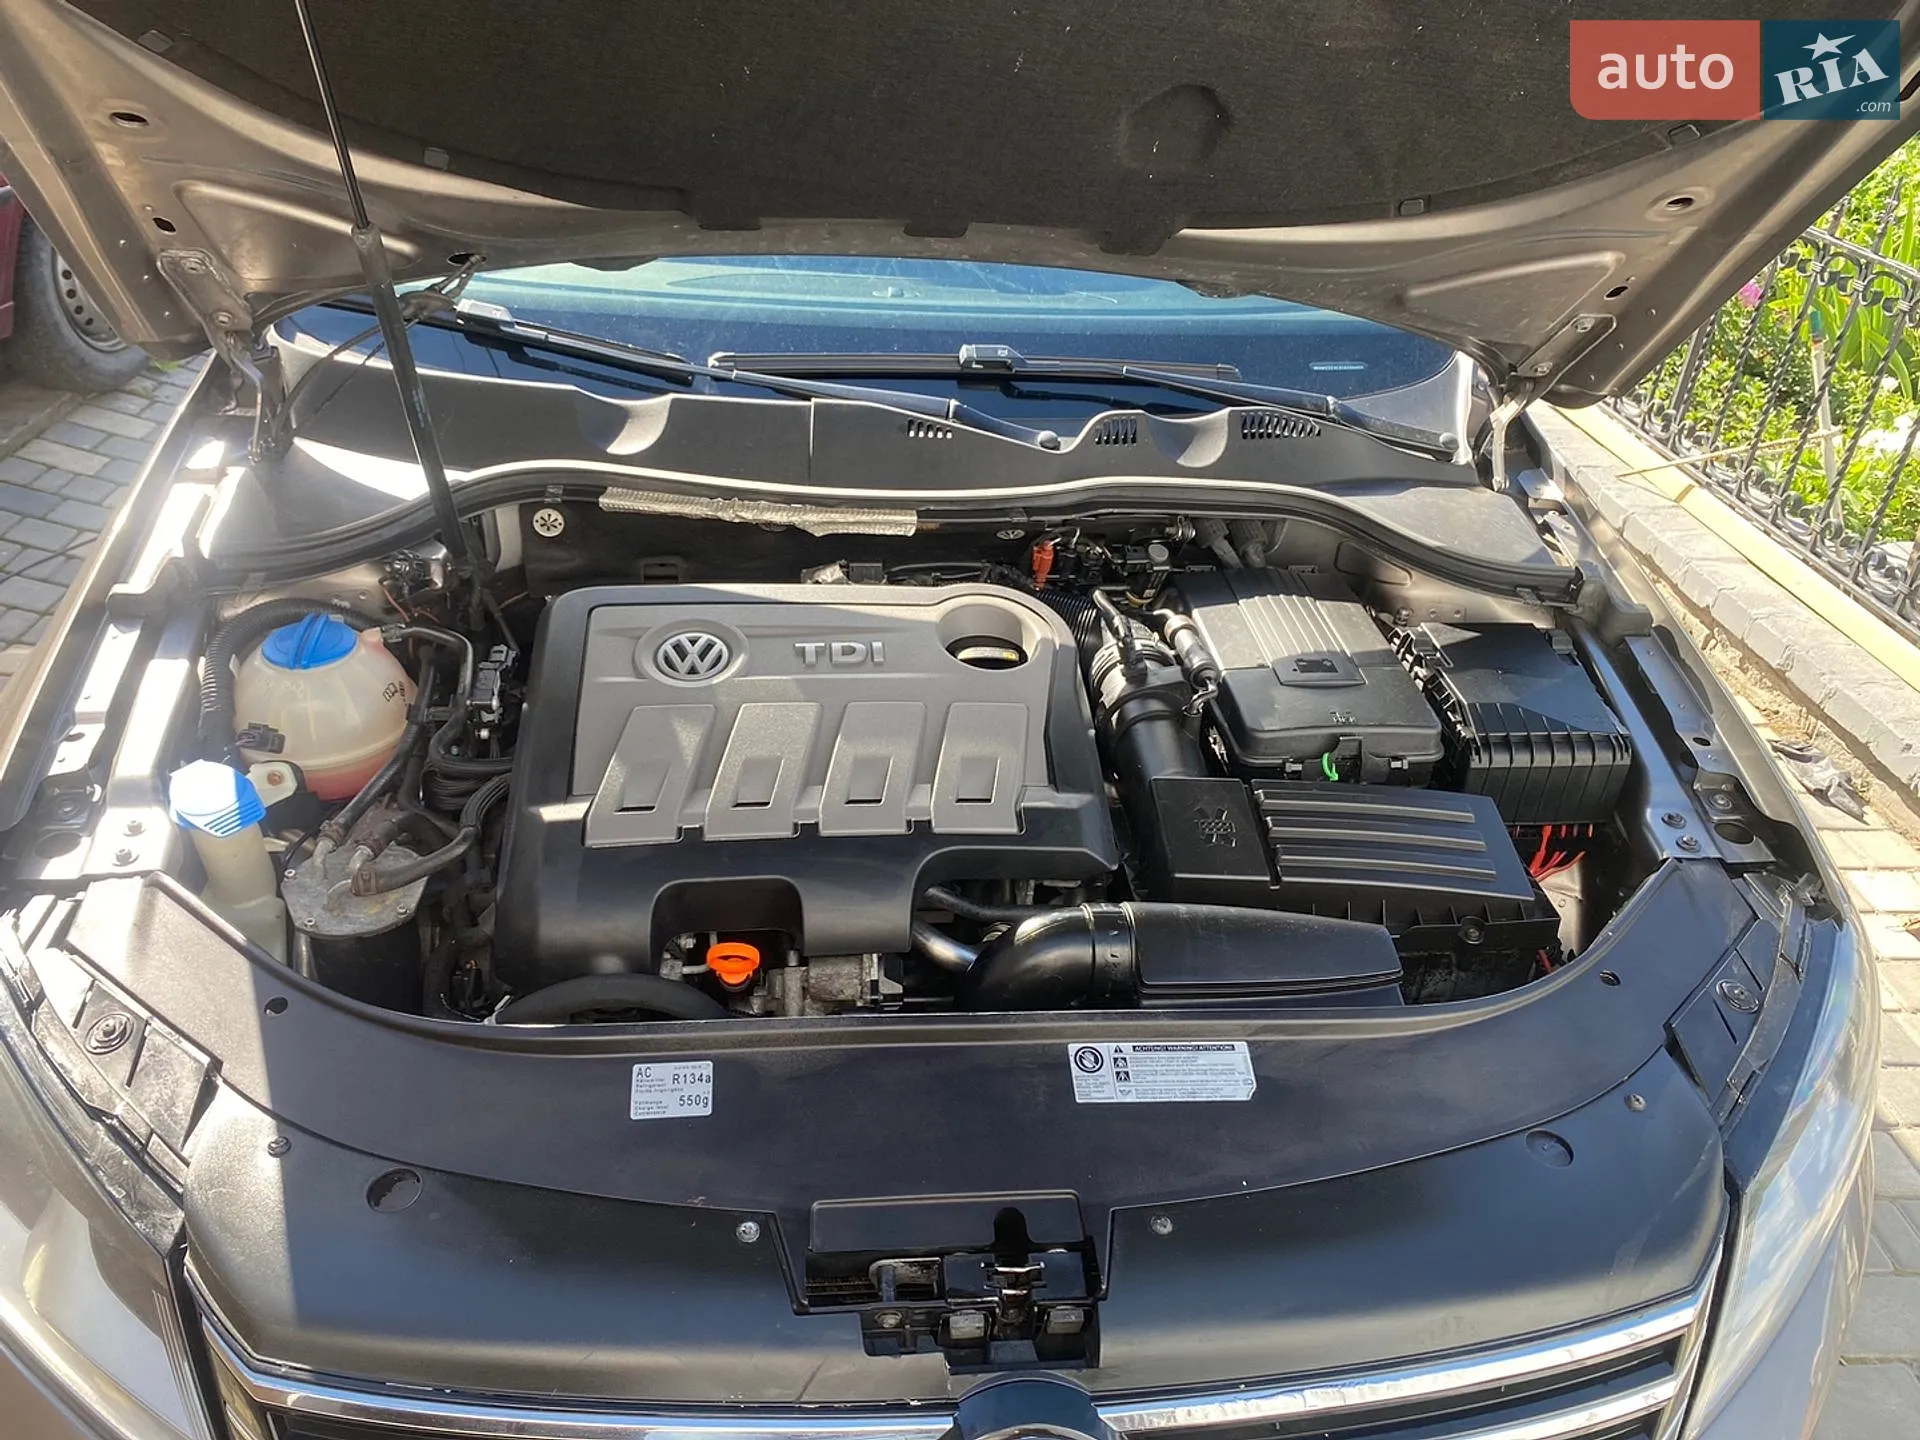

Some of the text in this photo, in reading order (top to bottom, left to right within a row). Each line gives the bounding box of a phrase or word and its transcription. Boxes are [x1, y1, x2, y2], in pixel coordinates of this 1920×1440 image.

[795, 641, 885, 666] TDI
[636, 1066, 652, 1079] AC
[672, 1073, 711, 1085] R134a
[678, 1094, 709, 1108] 550g
